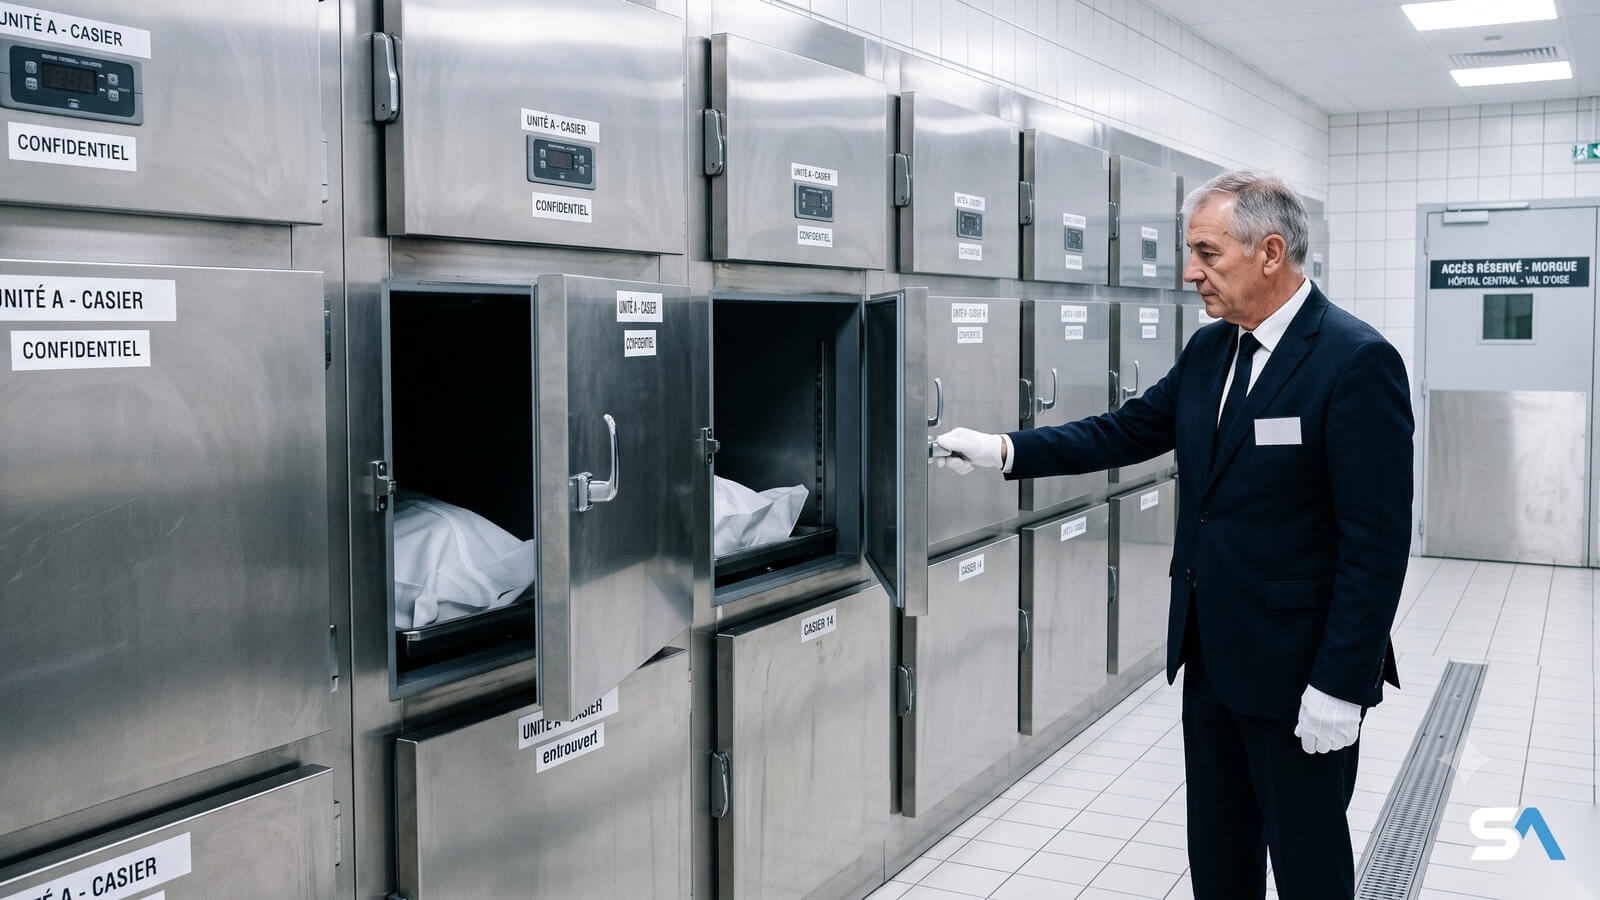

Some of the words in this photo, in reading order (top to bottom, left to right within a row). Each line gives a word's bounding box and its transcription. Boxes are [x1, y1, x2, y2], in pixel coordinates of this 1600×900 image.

[47, 20, 57, 35] A
[70, 24, 123, 46] CASIER
[526, 114, 549, 129] UNITÉ
[550, 119, 556, 130] A
[560, 120, 586, 135] CASIER
[17, 134, 129, 161] CONFIDENTIEL
[535, 199, 589, 216] CONFIDENTIEL
[1441, 261, 1474, 274] ACCÈS
[1476, 260, 1523, 274] RÉSERVÉ
[1531, 261, 1577, 273] MORGUE
[1447, 276, 1480, 286] HÔPITAL
[1482, 276, 1518, 285] CENTRAL
[1525, 275, 1540, 285] VAL
[1543, 275, 1570, 284] D'OISE
[0, 284, 46, 308] NITÉ
[52, 289, 64, 309] A
[82, 290, 143, 309] CASIER
[634, 301, 638, 314] A
[23, 340, 141, 360] CONFIDENTIEL
[803, 618, 825, 636] CASIER
[826, 615, 834, 627] 14
[543, 730, 598, 764] entrouvert
[92, 857, 157, 897] CASIER
